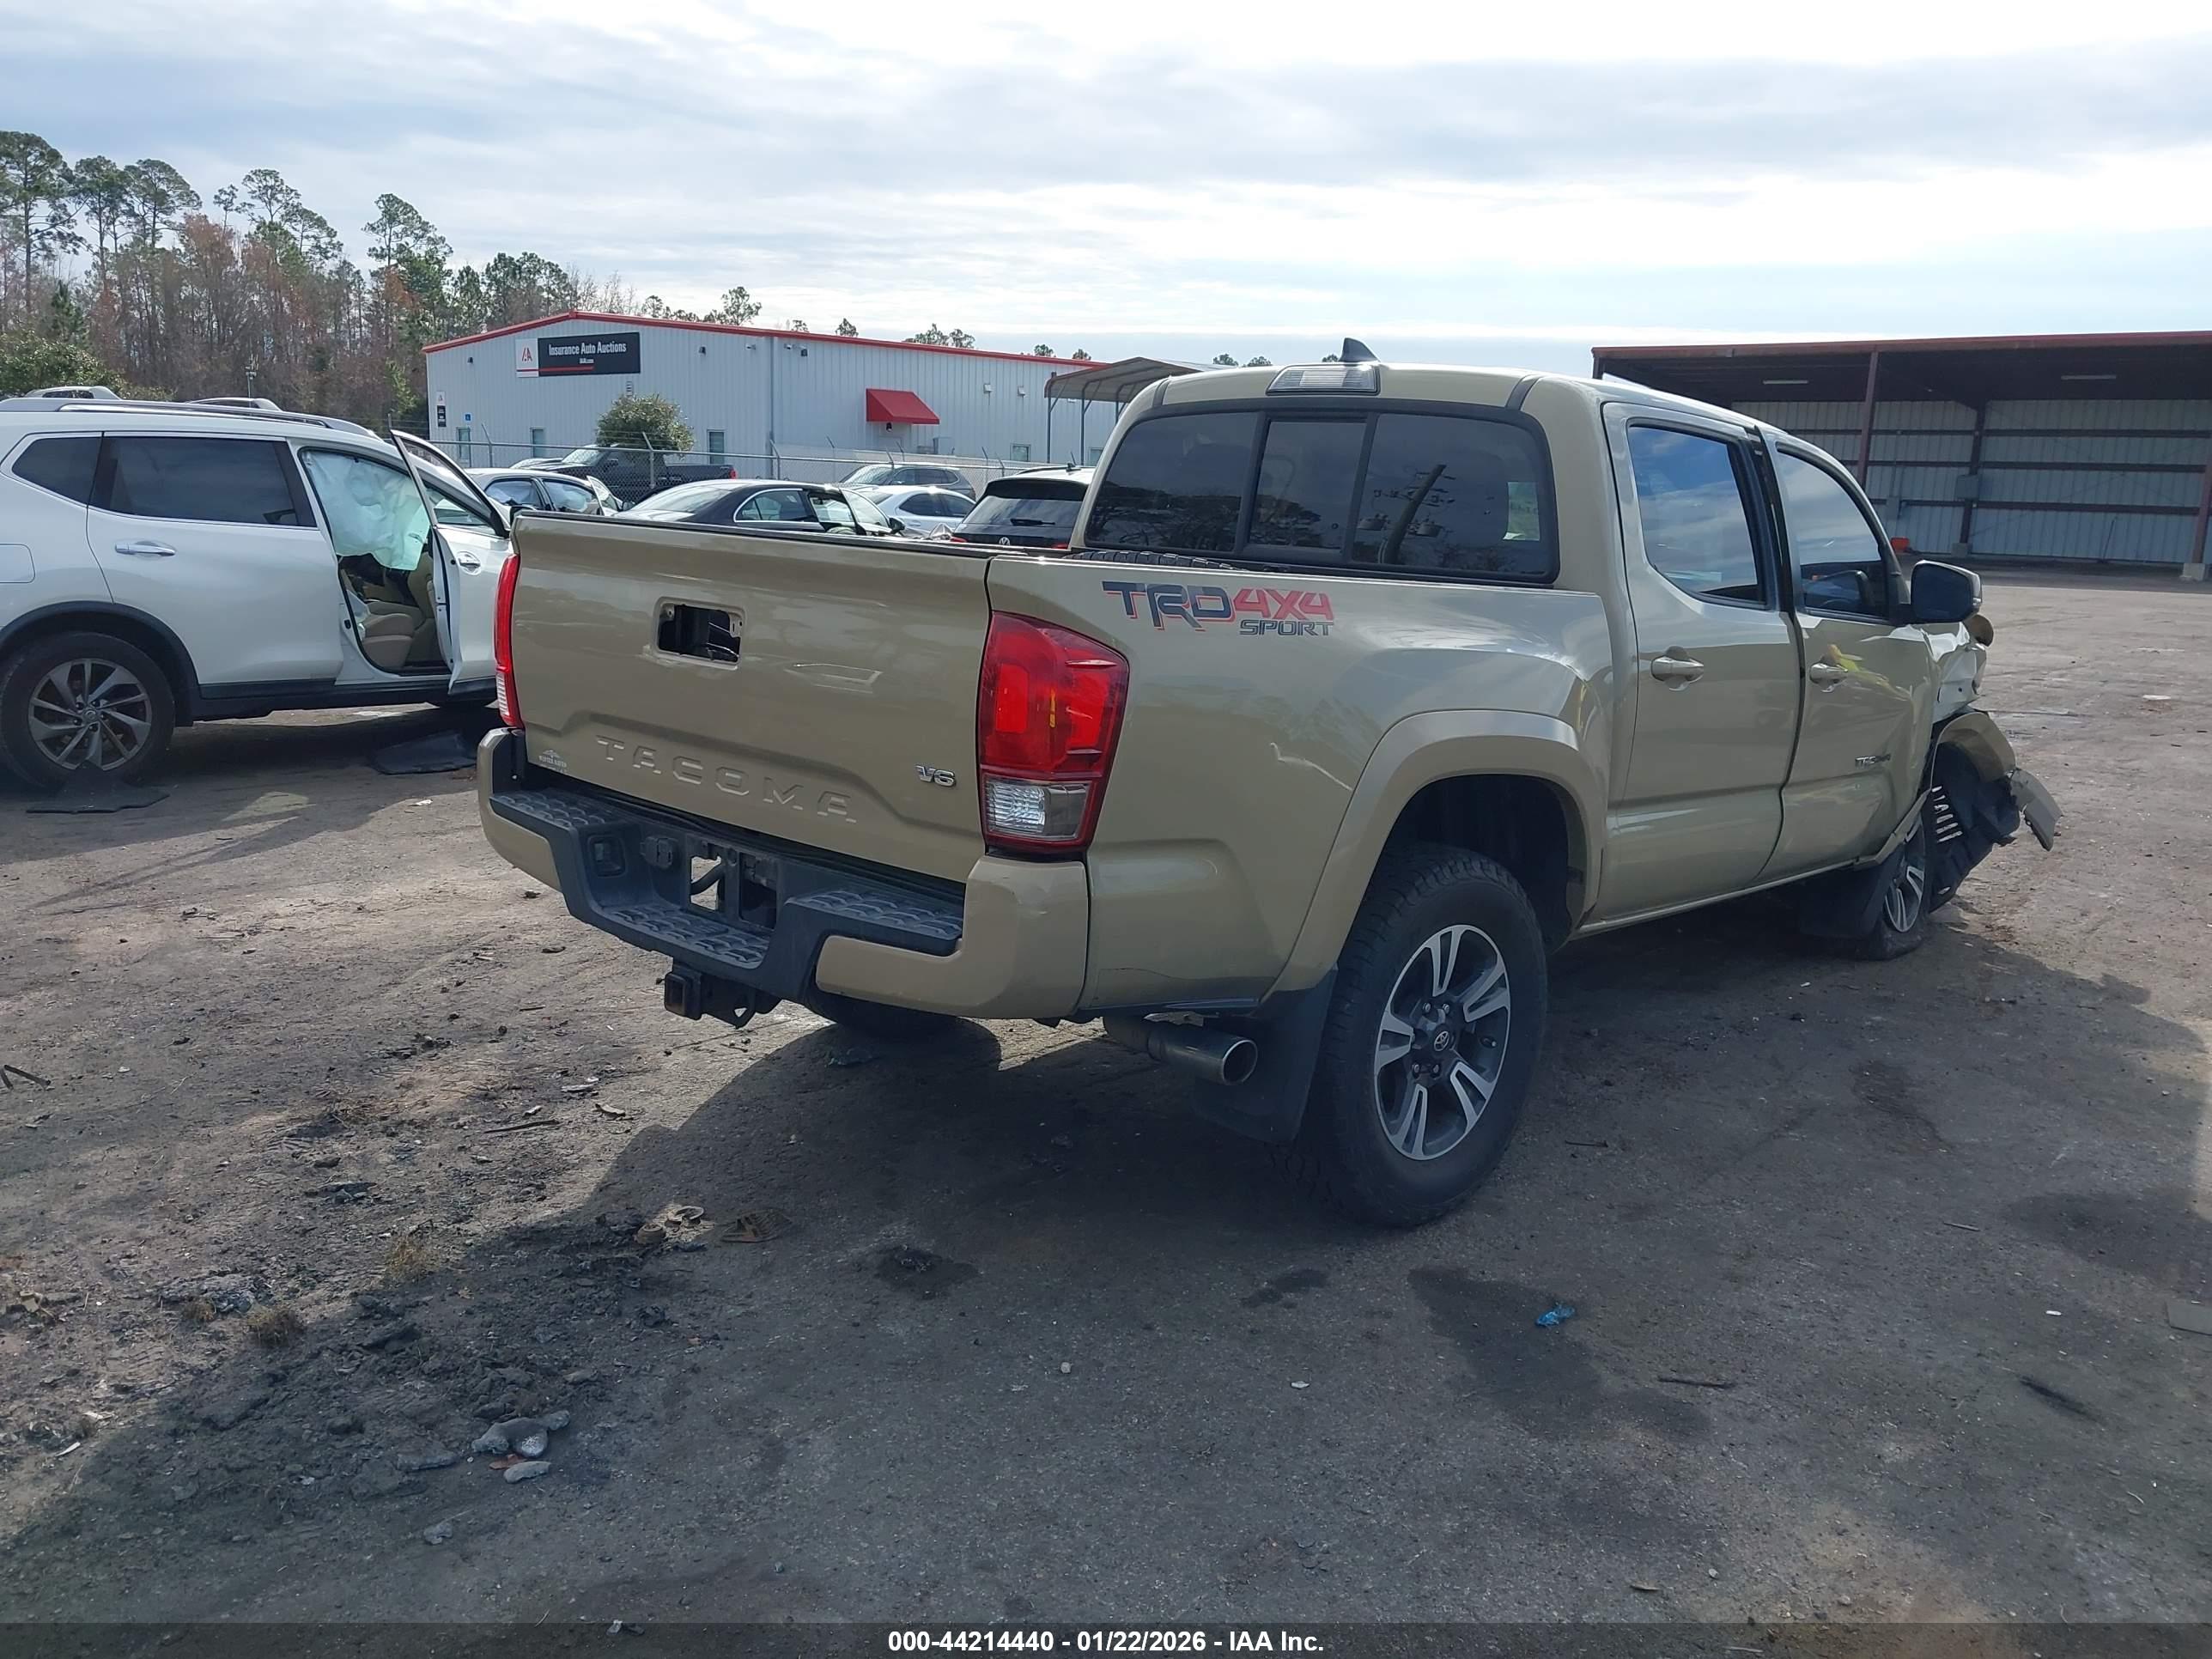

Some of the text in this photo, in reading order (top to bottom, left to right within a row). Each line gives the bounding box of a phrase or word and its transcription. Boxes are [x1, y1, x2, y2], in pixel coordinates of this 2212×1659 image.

[549, 341, 627, 356] Insurance Auto Auctions
[1102, 580, 1236, 631] TRD
[1239, 619, 1334, 635] SPORT
[595, 735, 857, 823] TACOMA
[915, 764, 956, 787] V6
